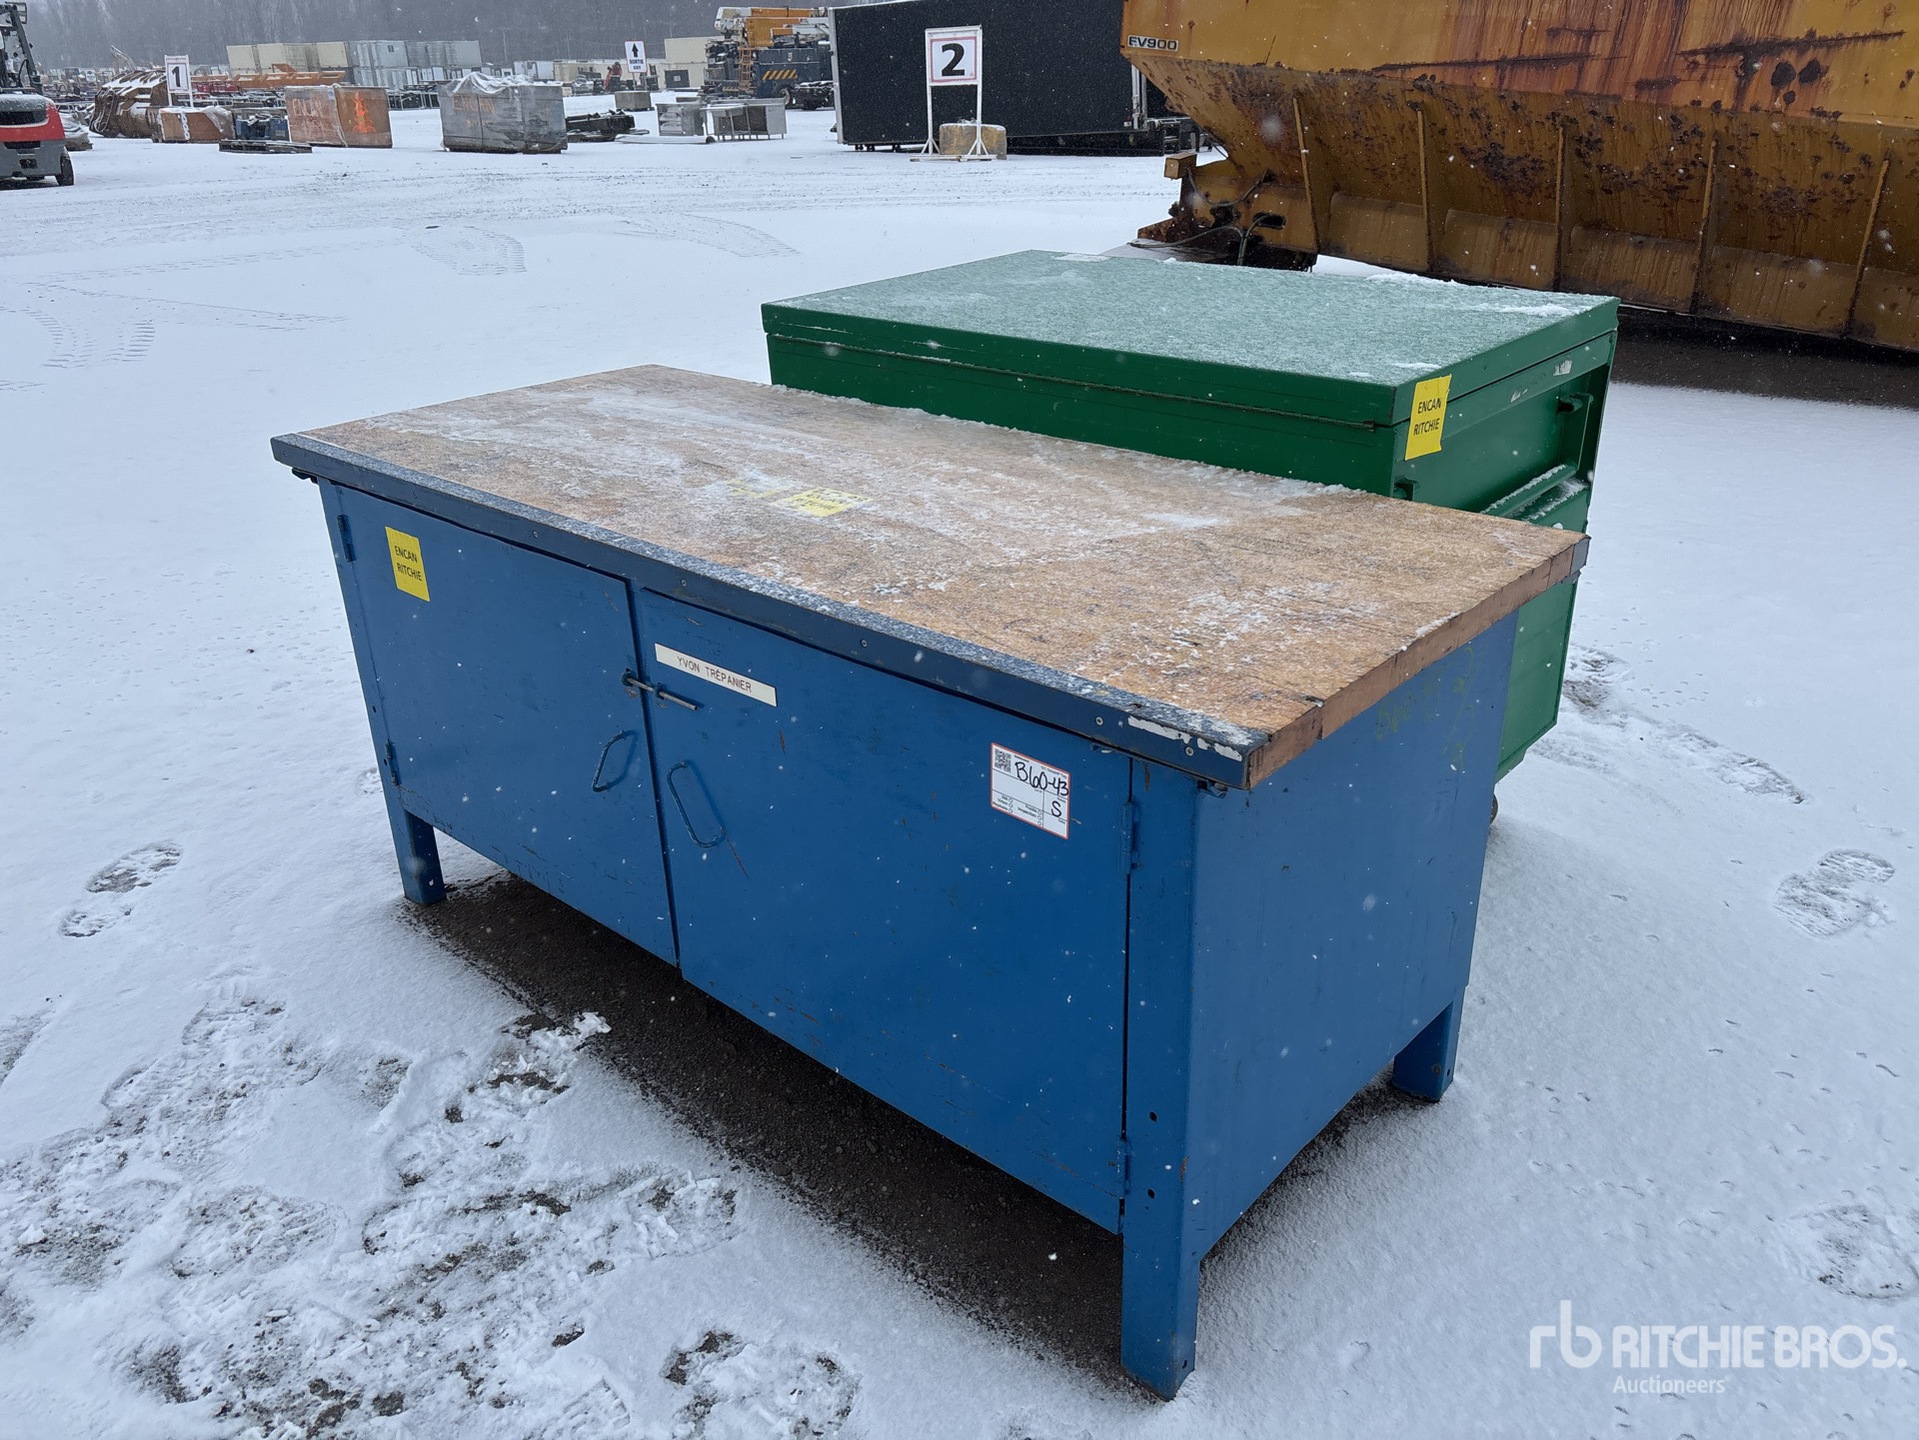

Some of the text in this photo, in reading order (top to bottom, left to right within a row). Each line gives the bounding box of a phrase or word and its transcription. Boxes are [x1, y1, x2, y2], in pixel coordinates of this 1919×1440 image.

[1128, 36, 1177, 50] EV900
[941, 43, 965, 76] 2
[171, 66, 181, 88] 1
[1417, 397, 1442, 414] ENCAN
[1413, 418, 1440, 436] RITCHIE
[394, 545, 418, 563] ENCAN
[396, 562, 422, 582] RITCHIE
[677, 656, 752, 693] YVON TRÉPANIER
